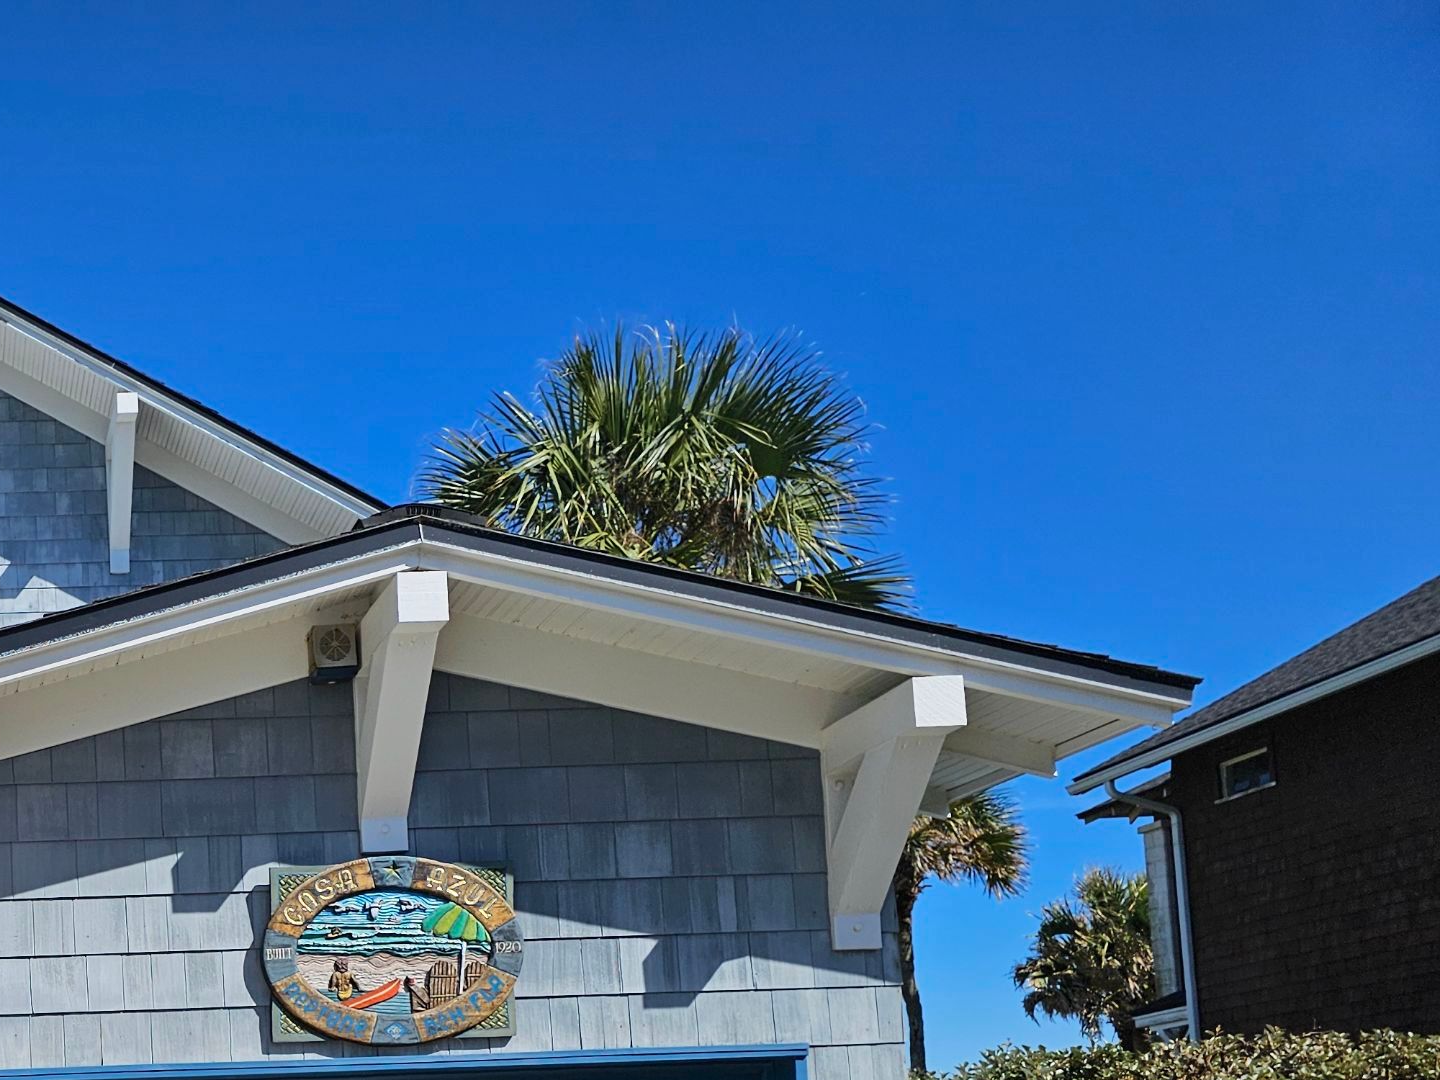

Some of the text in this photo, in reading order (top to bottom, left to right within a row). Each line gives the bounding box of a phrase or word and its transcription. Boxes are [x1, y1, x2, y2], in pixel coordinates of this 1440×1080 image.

[283, 867, 498, 926] CASA AZUL
[265, 941, 522, 960] BUILT 1920
